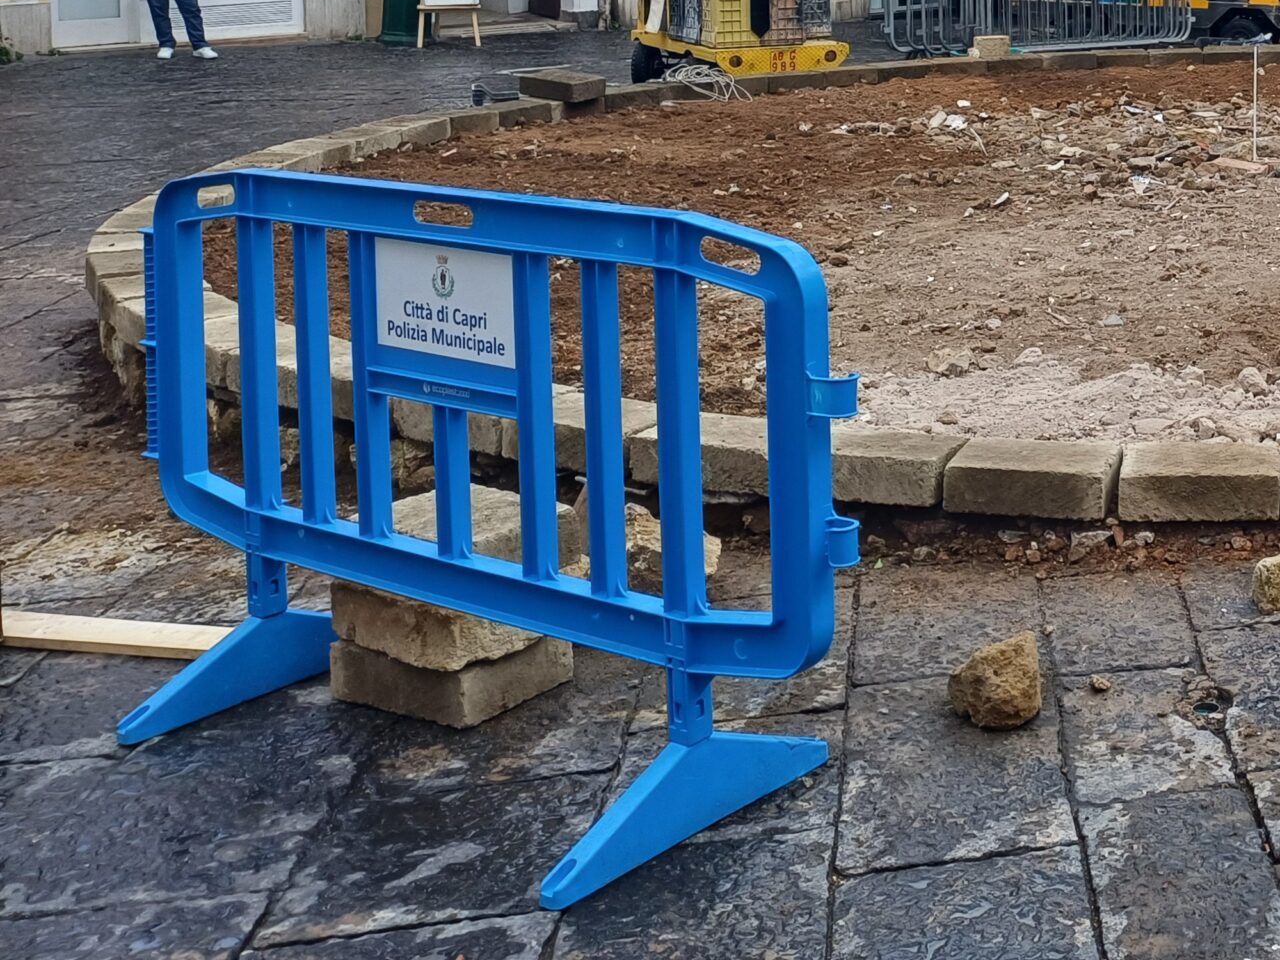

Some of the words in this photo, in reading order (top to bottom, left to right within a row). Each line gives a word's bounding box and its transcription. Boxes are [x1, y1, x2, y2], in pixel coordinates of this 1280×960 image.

[404, 300, 432, 321] Città
[437, 305, 449, 323] di
[453, 308, 487, 332] Capri
[388, 320, 428, 342] Polizia
[432, 328, 505, 356] Municipale
